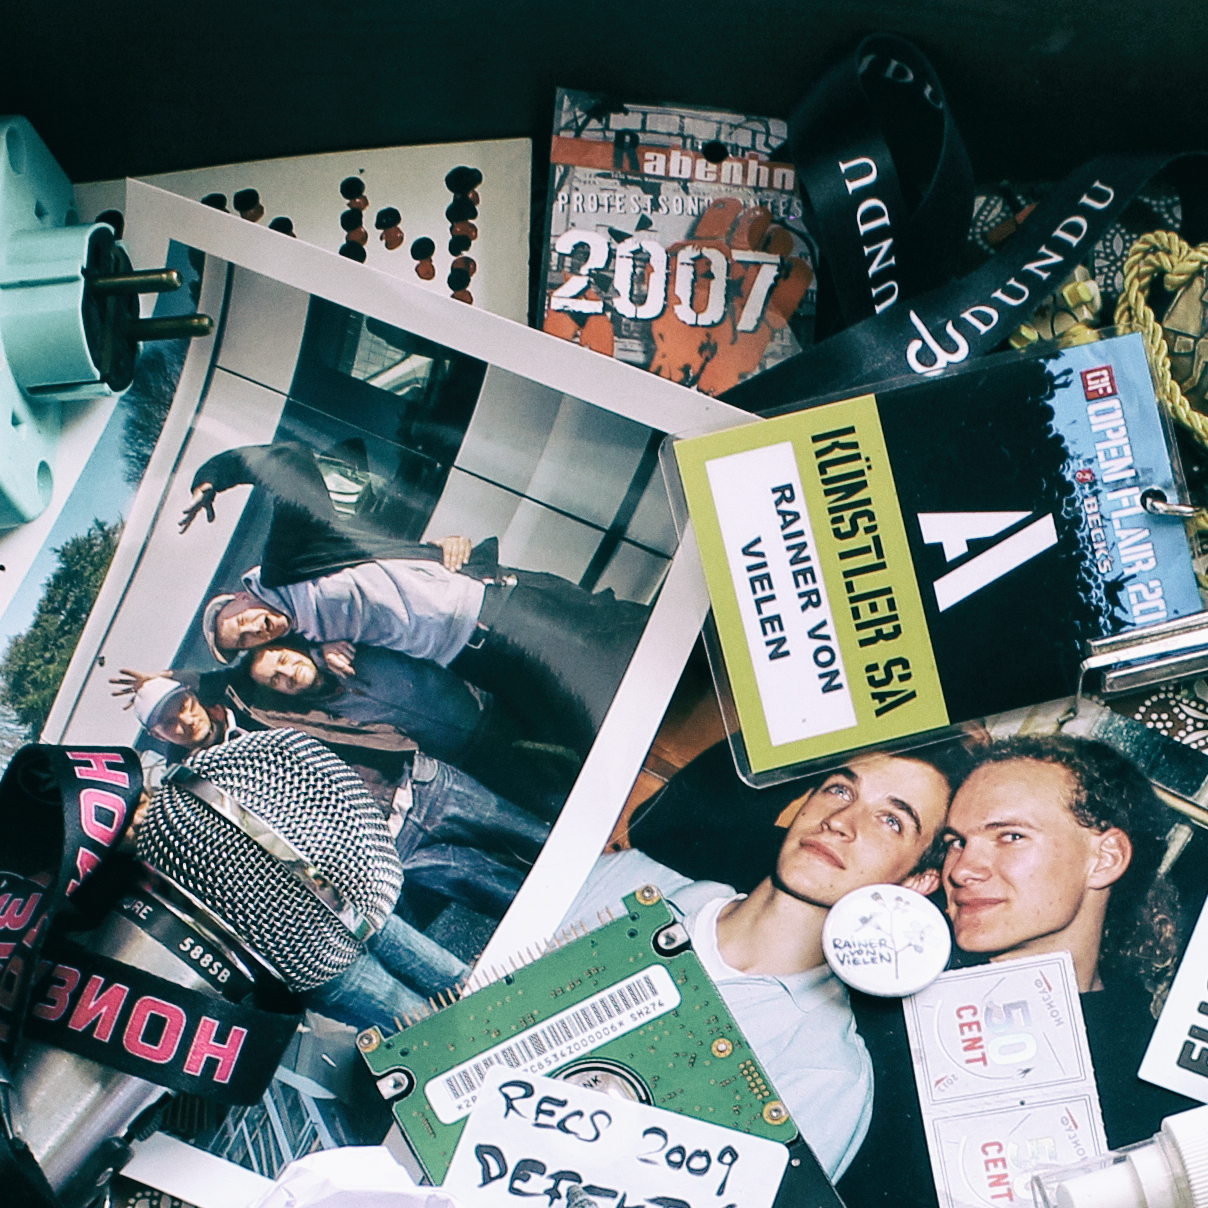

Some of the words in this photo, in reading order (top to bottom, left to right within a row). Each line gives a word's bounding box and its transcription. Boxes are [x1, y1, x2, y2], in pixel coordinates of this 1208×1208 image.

[550, 229, 782, 333] 2007
[960, 179, 1116, 337] DUNDU
[1085, 399, 1138, 484] OPEN
[810, 424, 904, 649] KÜNSTLER
[865, 655, 918, 718] SA
[916, 510, 1060, 613] A
[1084, 497, 1113, 575] BECK'S
[1108, 485, 1160, 579] FLAIR
[741, 535, 792, 662] VIELEN
[769, 481, 823, 614] RAINER
[806, 617, 844, 695] VON
[177, 934, 232, 985] 588SB
[954, 1003, 987, 1070] CENT
[980, 998, 1040, 1066] 50
[497, 1078, 613, 1145] RECS
[635, 1125, 741, 1198] 2009
[979, 1140, 1013, 1205] CENT
